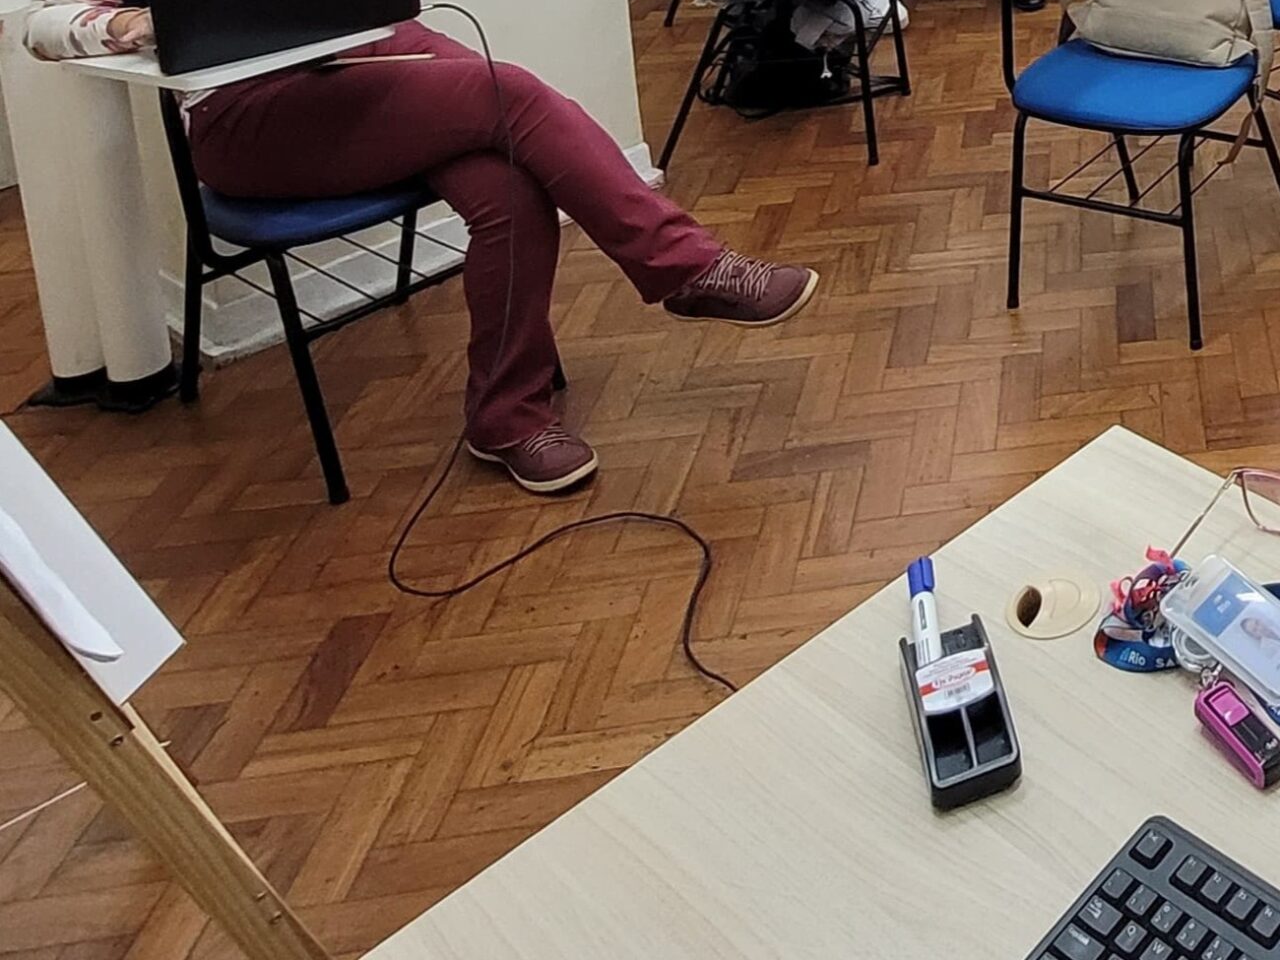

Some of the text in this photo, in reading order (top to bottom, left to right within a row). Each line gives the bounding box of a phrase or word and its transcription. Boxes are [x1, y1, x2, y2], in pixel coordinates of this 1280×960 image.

[1127, 650, 1146, 666] Rio
[1126, 924, 1137, 938] Q
[1151, 940, 1165, 955] W
